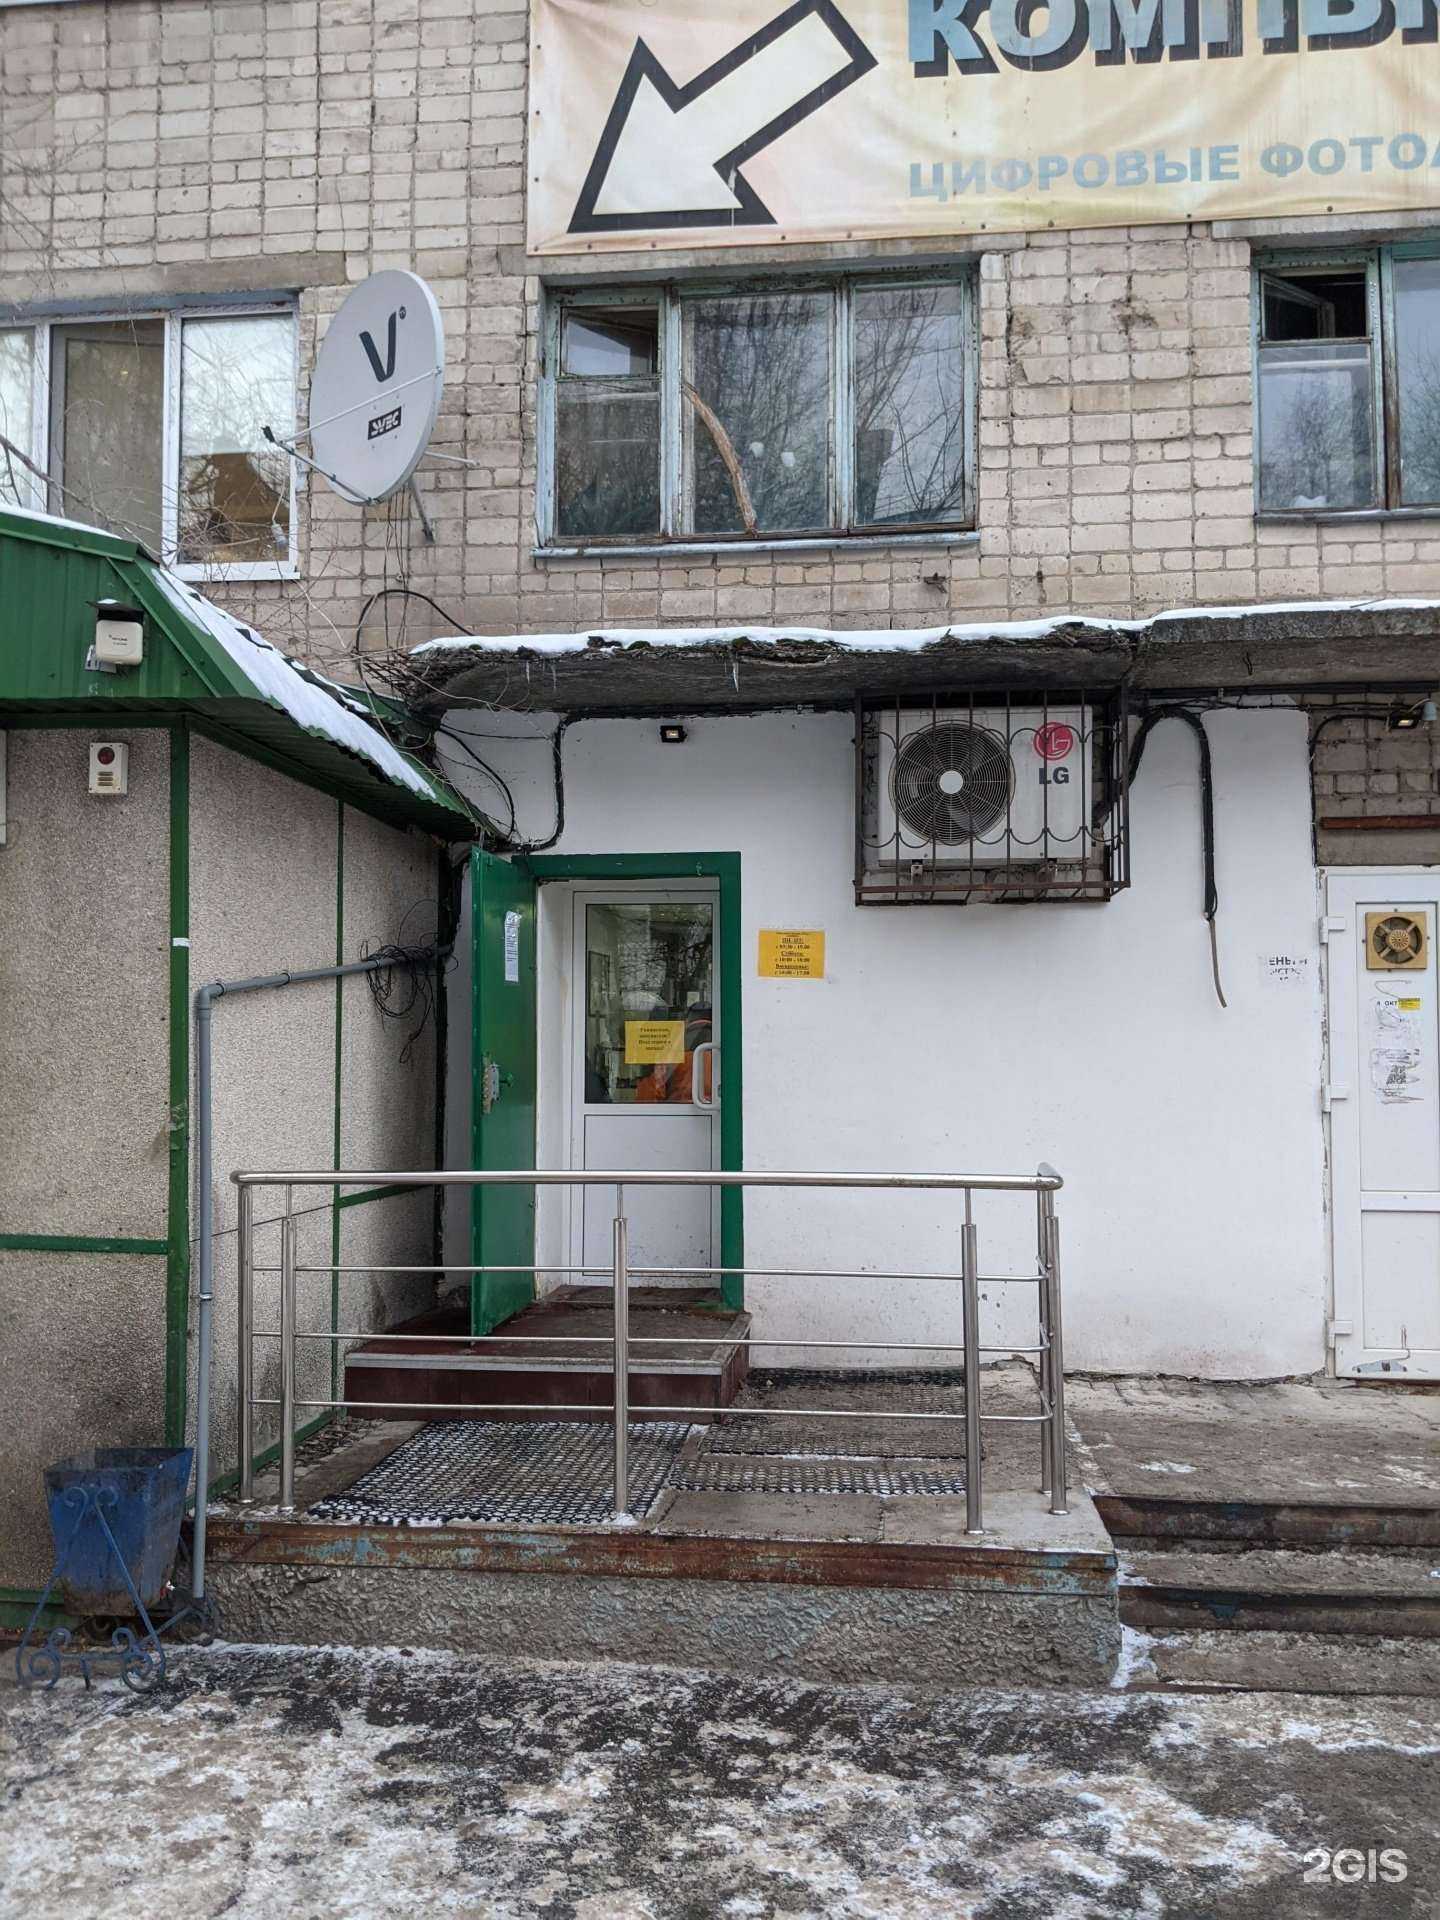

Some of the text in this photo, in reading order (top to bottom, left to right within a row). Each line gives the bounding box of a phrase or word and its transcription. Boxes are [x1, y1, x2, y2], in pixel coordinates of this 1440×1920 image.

[908, 0, 1440, 78] КОМПЬ
[909, 132, 1440, 203] ЦИФРОВЫЕ ФОТО
[1039, 766, 1070, 785] LG
